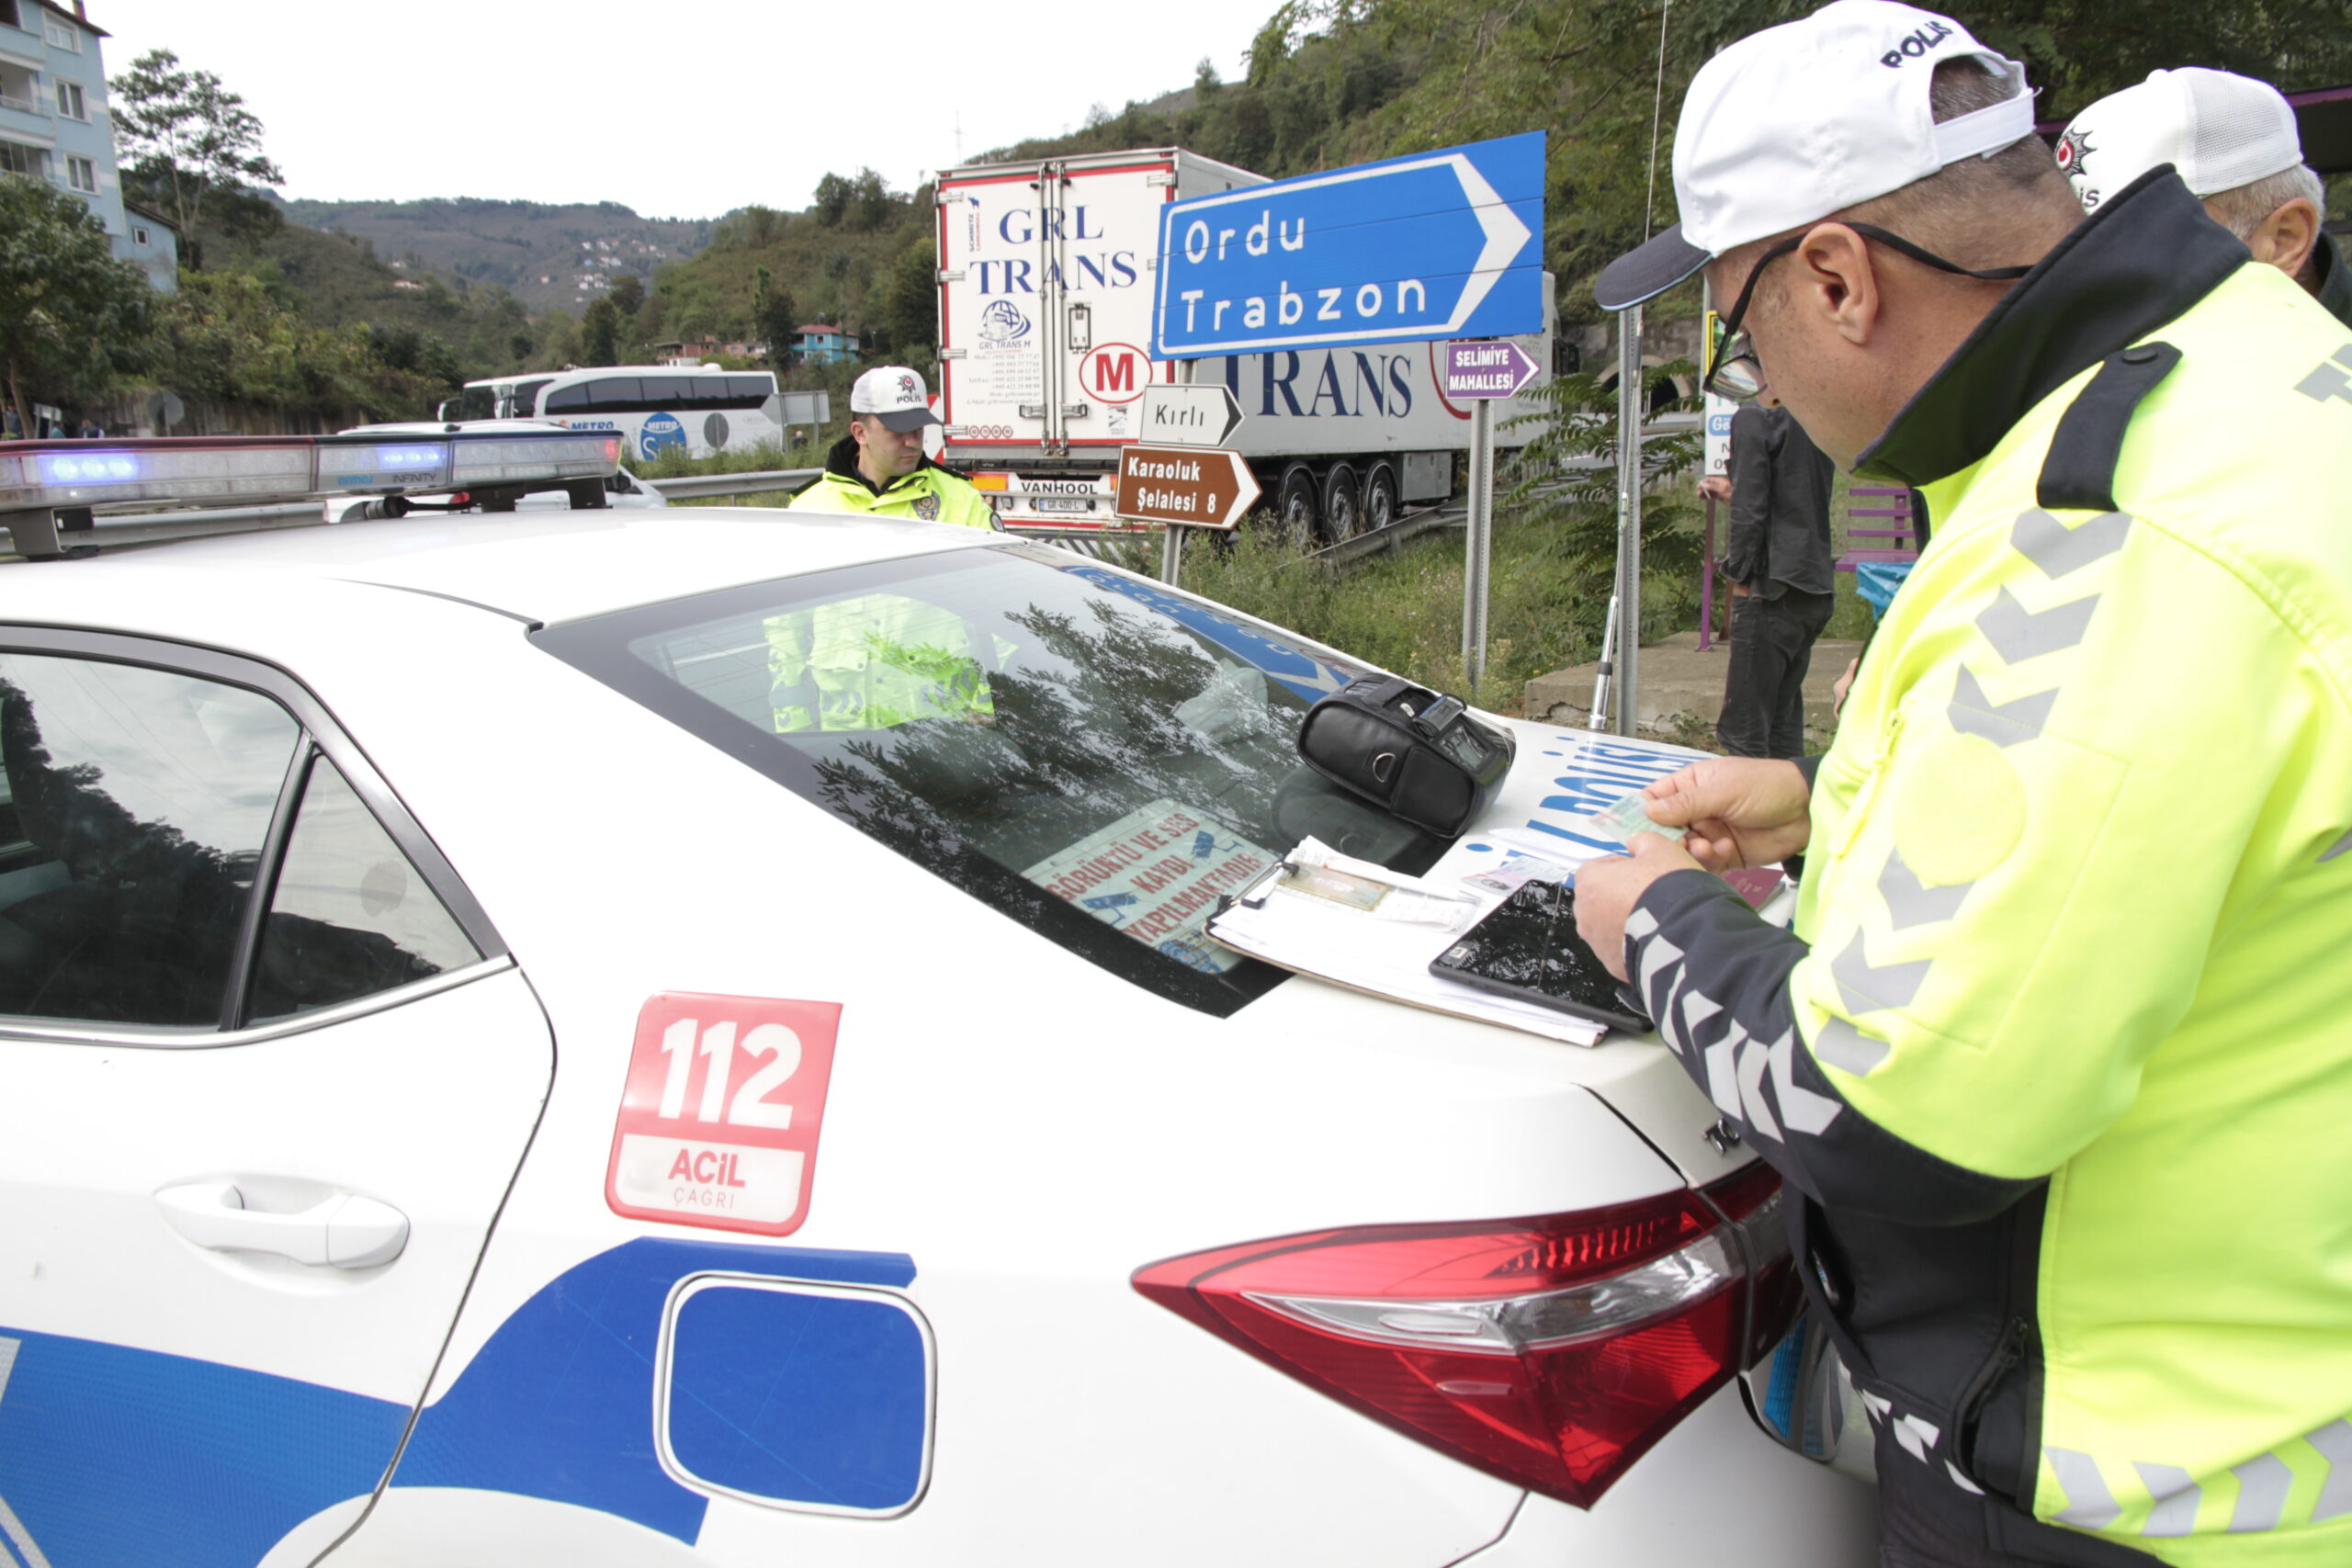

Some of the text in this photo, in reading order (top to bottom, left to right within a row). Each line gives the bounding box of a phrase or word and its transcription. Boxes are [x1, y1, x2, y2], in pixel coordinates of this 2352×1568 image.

[999, 205, 1103, 244] GRL
[1184, 209, 1305, 264] Ordu
[969, 251, 1137, 296] TRANS
[1181, 279, 1426, 333] Trabzon
[1095, 353, 1134, 392] M
[1455, 345, 1510, 367] SELİMİYE
[1220, 346, 1412, 418] TRANS
[1449, 368, 1514, 390] MAHALLESİ
[567, 421, 614, 430] METRO
[648, 421, 677, 432] METRO
[1156, 404, 1204, 426] Kırlı
[1022, 482, 1098, 495] VANHOOL
[1127, 457, 1201, 481] Karaoluk
[1137, 487, 1216, 514] Şelalesi 8
[1045, 812, 1200, 903] GÖRÜNTÜ VE SES
[1129, 854, 1195, 894] KAYDI
[657, 1018, 802, 1130] 112
[668, 1148, 746, 1188] ACİL
[673, 1187, 734, 1209] ÇAĞRI
